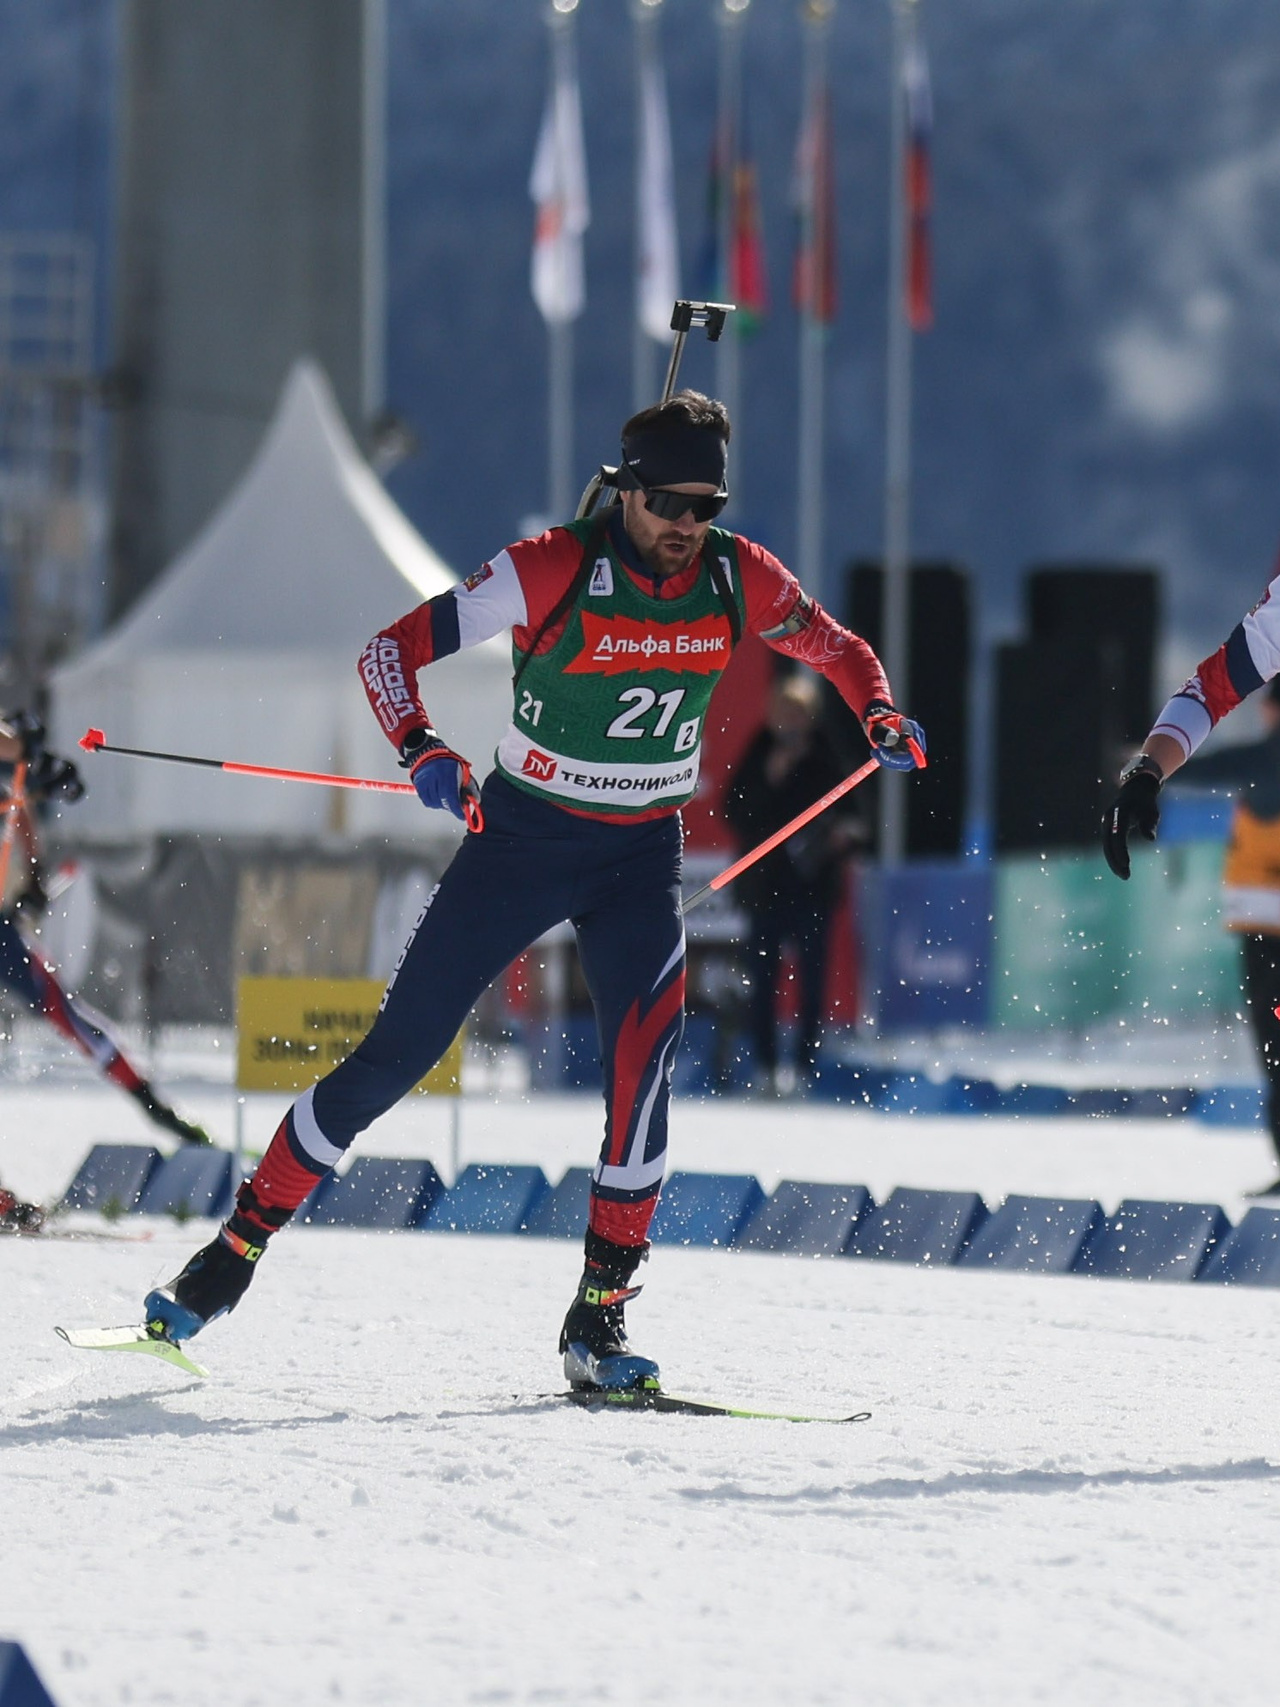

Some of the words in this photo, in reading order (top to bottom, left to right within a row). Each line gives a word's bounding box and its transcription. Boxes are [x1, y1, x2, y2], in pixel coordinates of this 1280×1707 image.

[592, 634, 671, 661] Альфа
[675, 635, 725, 654] Банк
[519, 690, 543, 726] 21
[605, 686, 686, 739] 21
[682, 725, 694, 747] 2
